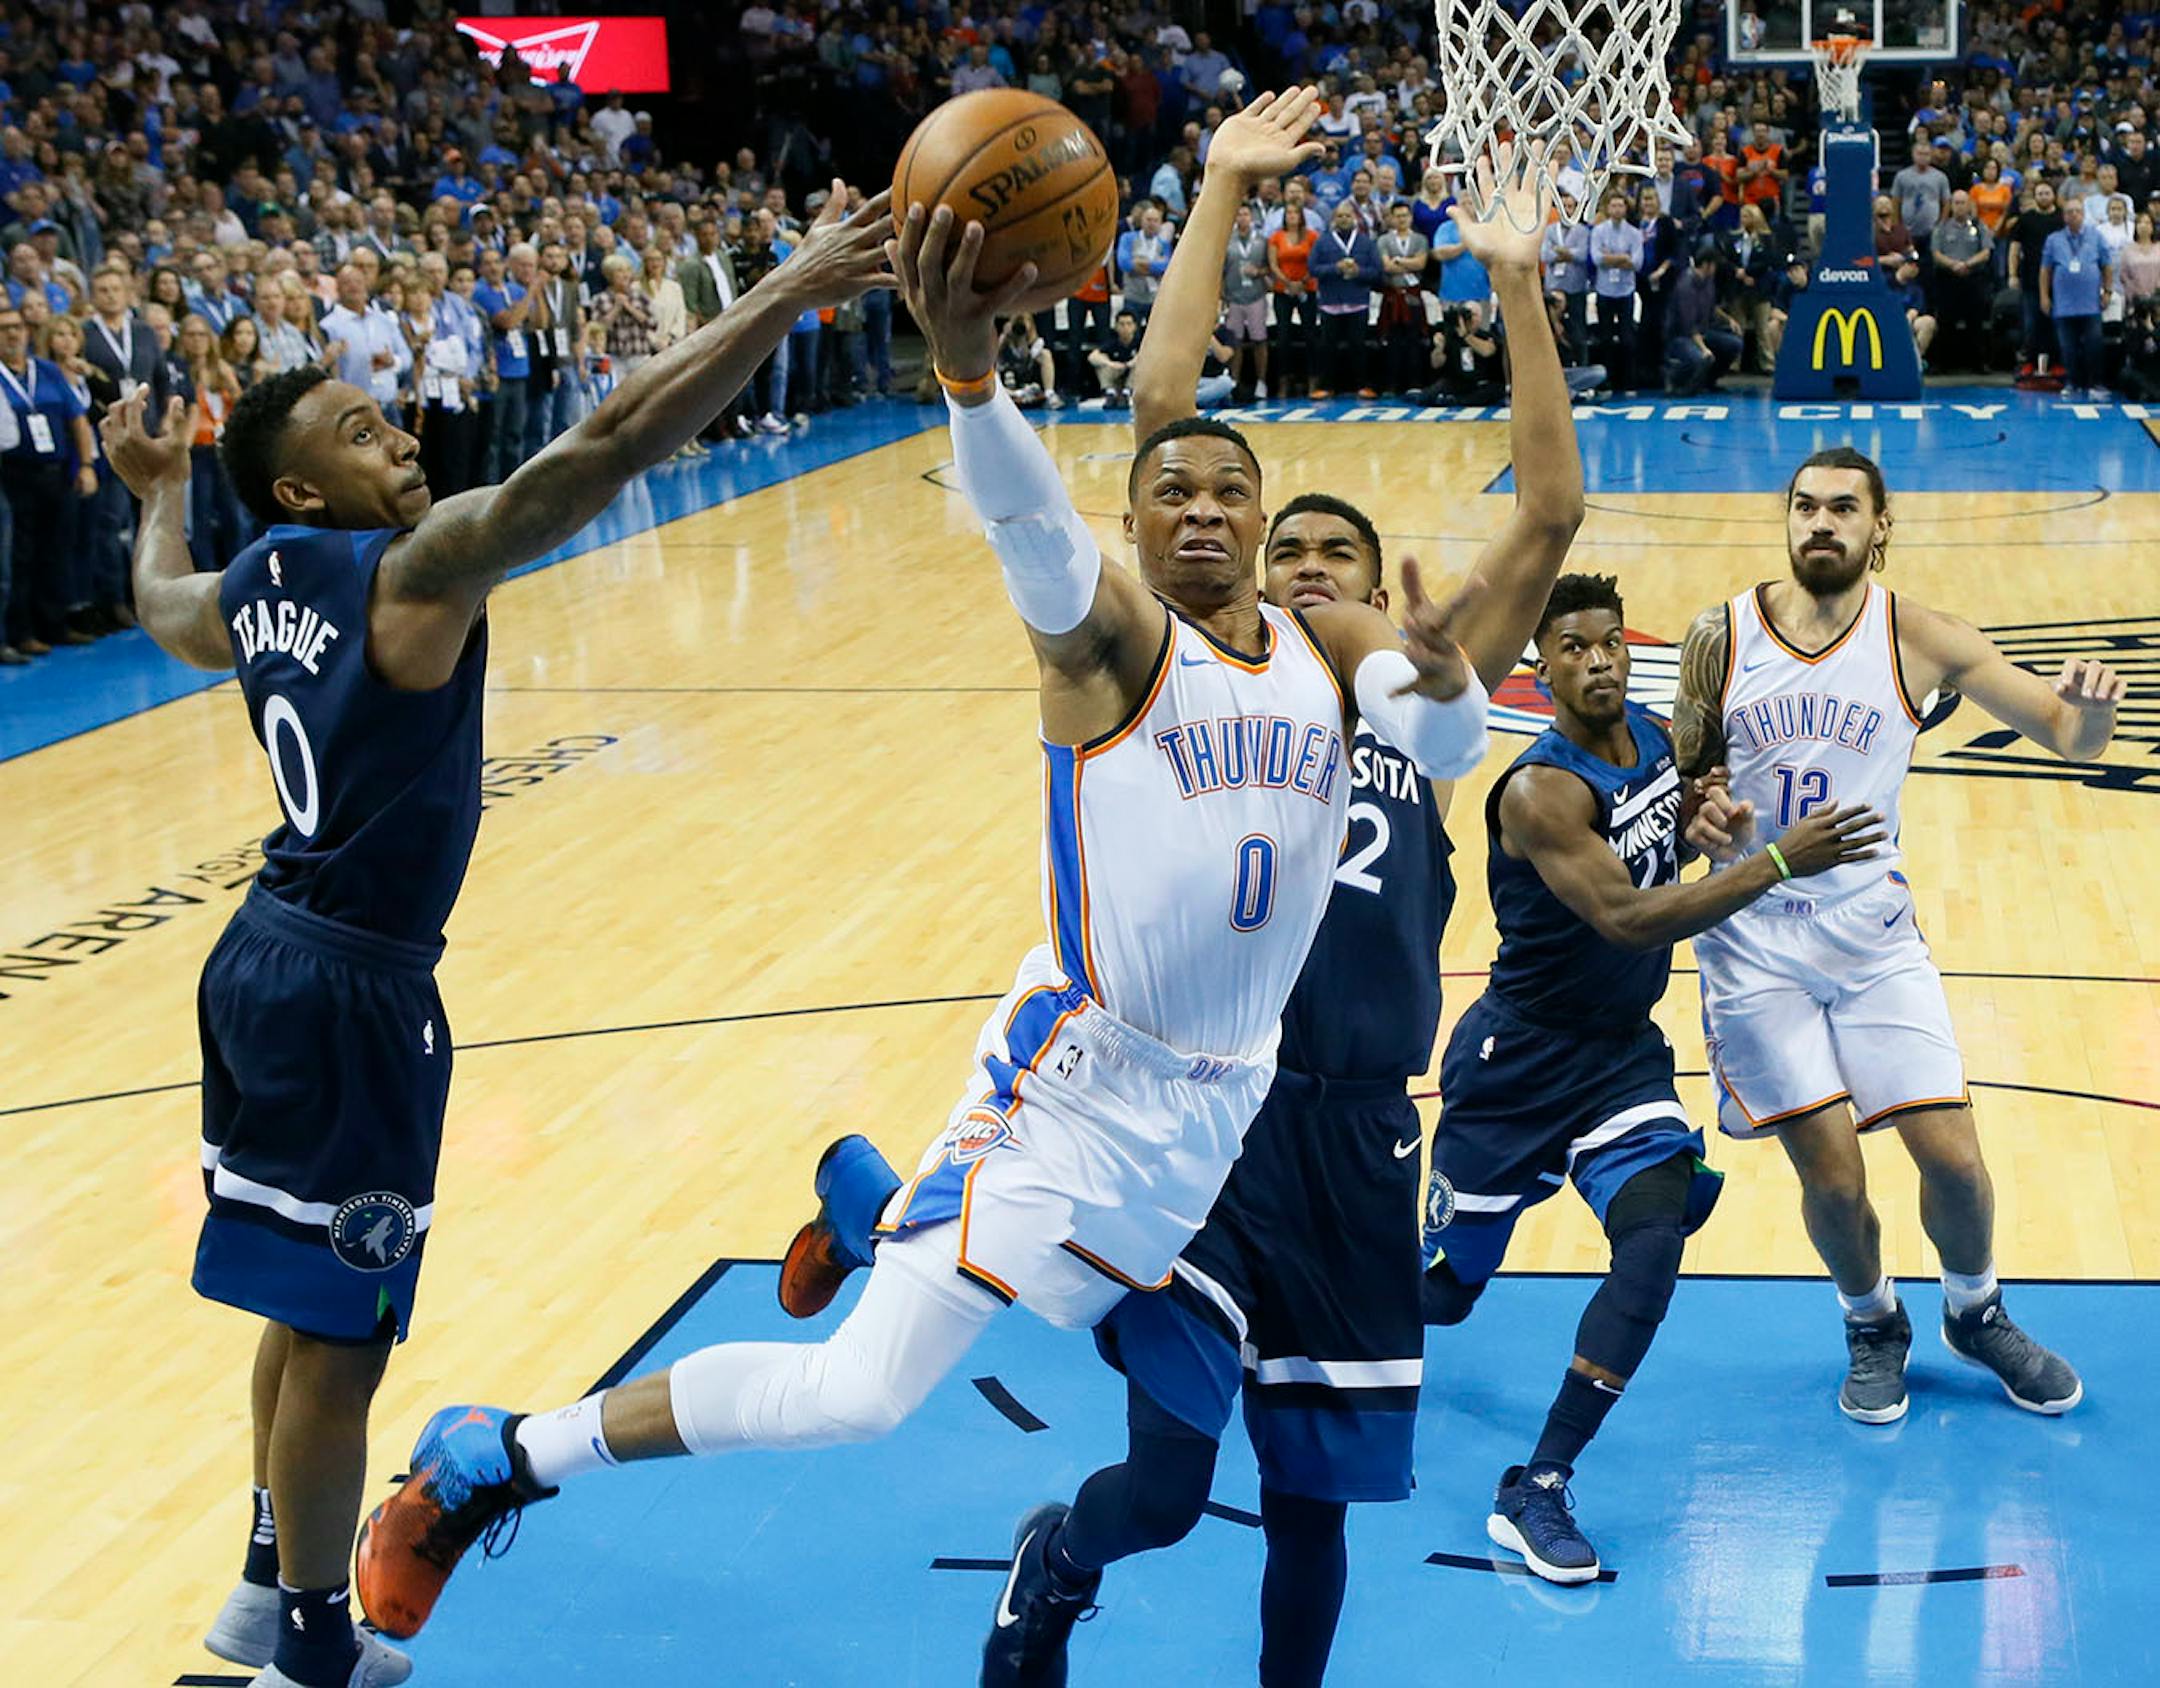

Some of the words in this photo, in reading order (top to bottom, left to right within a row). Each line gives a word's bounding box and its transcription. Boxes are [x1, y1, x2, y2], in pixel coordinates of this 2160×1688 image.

[1819, 267, 1870, 282] devon
[1197, 404, 1730, 421] KLAHMA
[1778, 404, 2007, 420] CITY
[232, 599, 340, 676] TEAGUE
[1154, 715, 1343, 805] THUNDER
[1734, 693, 1886, 756] THUNDER
[264, 694, 319, 838] 0
[1351, 746, 1421, 805] SOTA
[1773, 764, 1833, 829] 12
[1229, 832, 1279, 933] 0
[0, 885, 206, 1000] AREN
